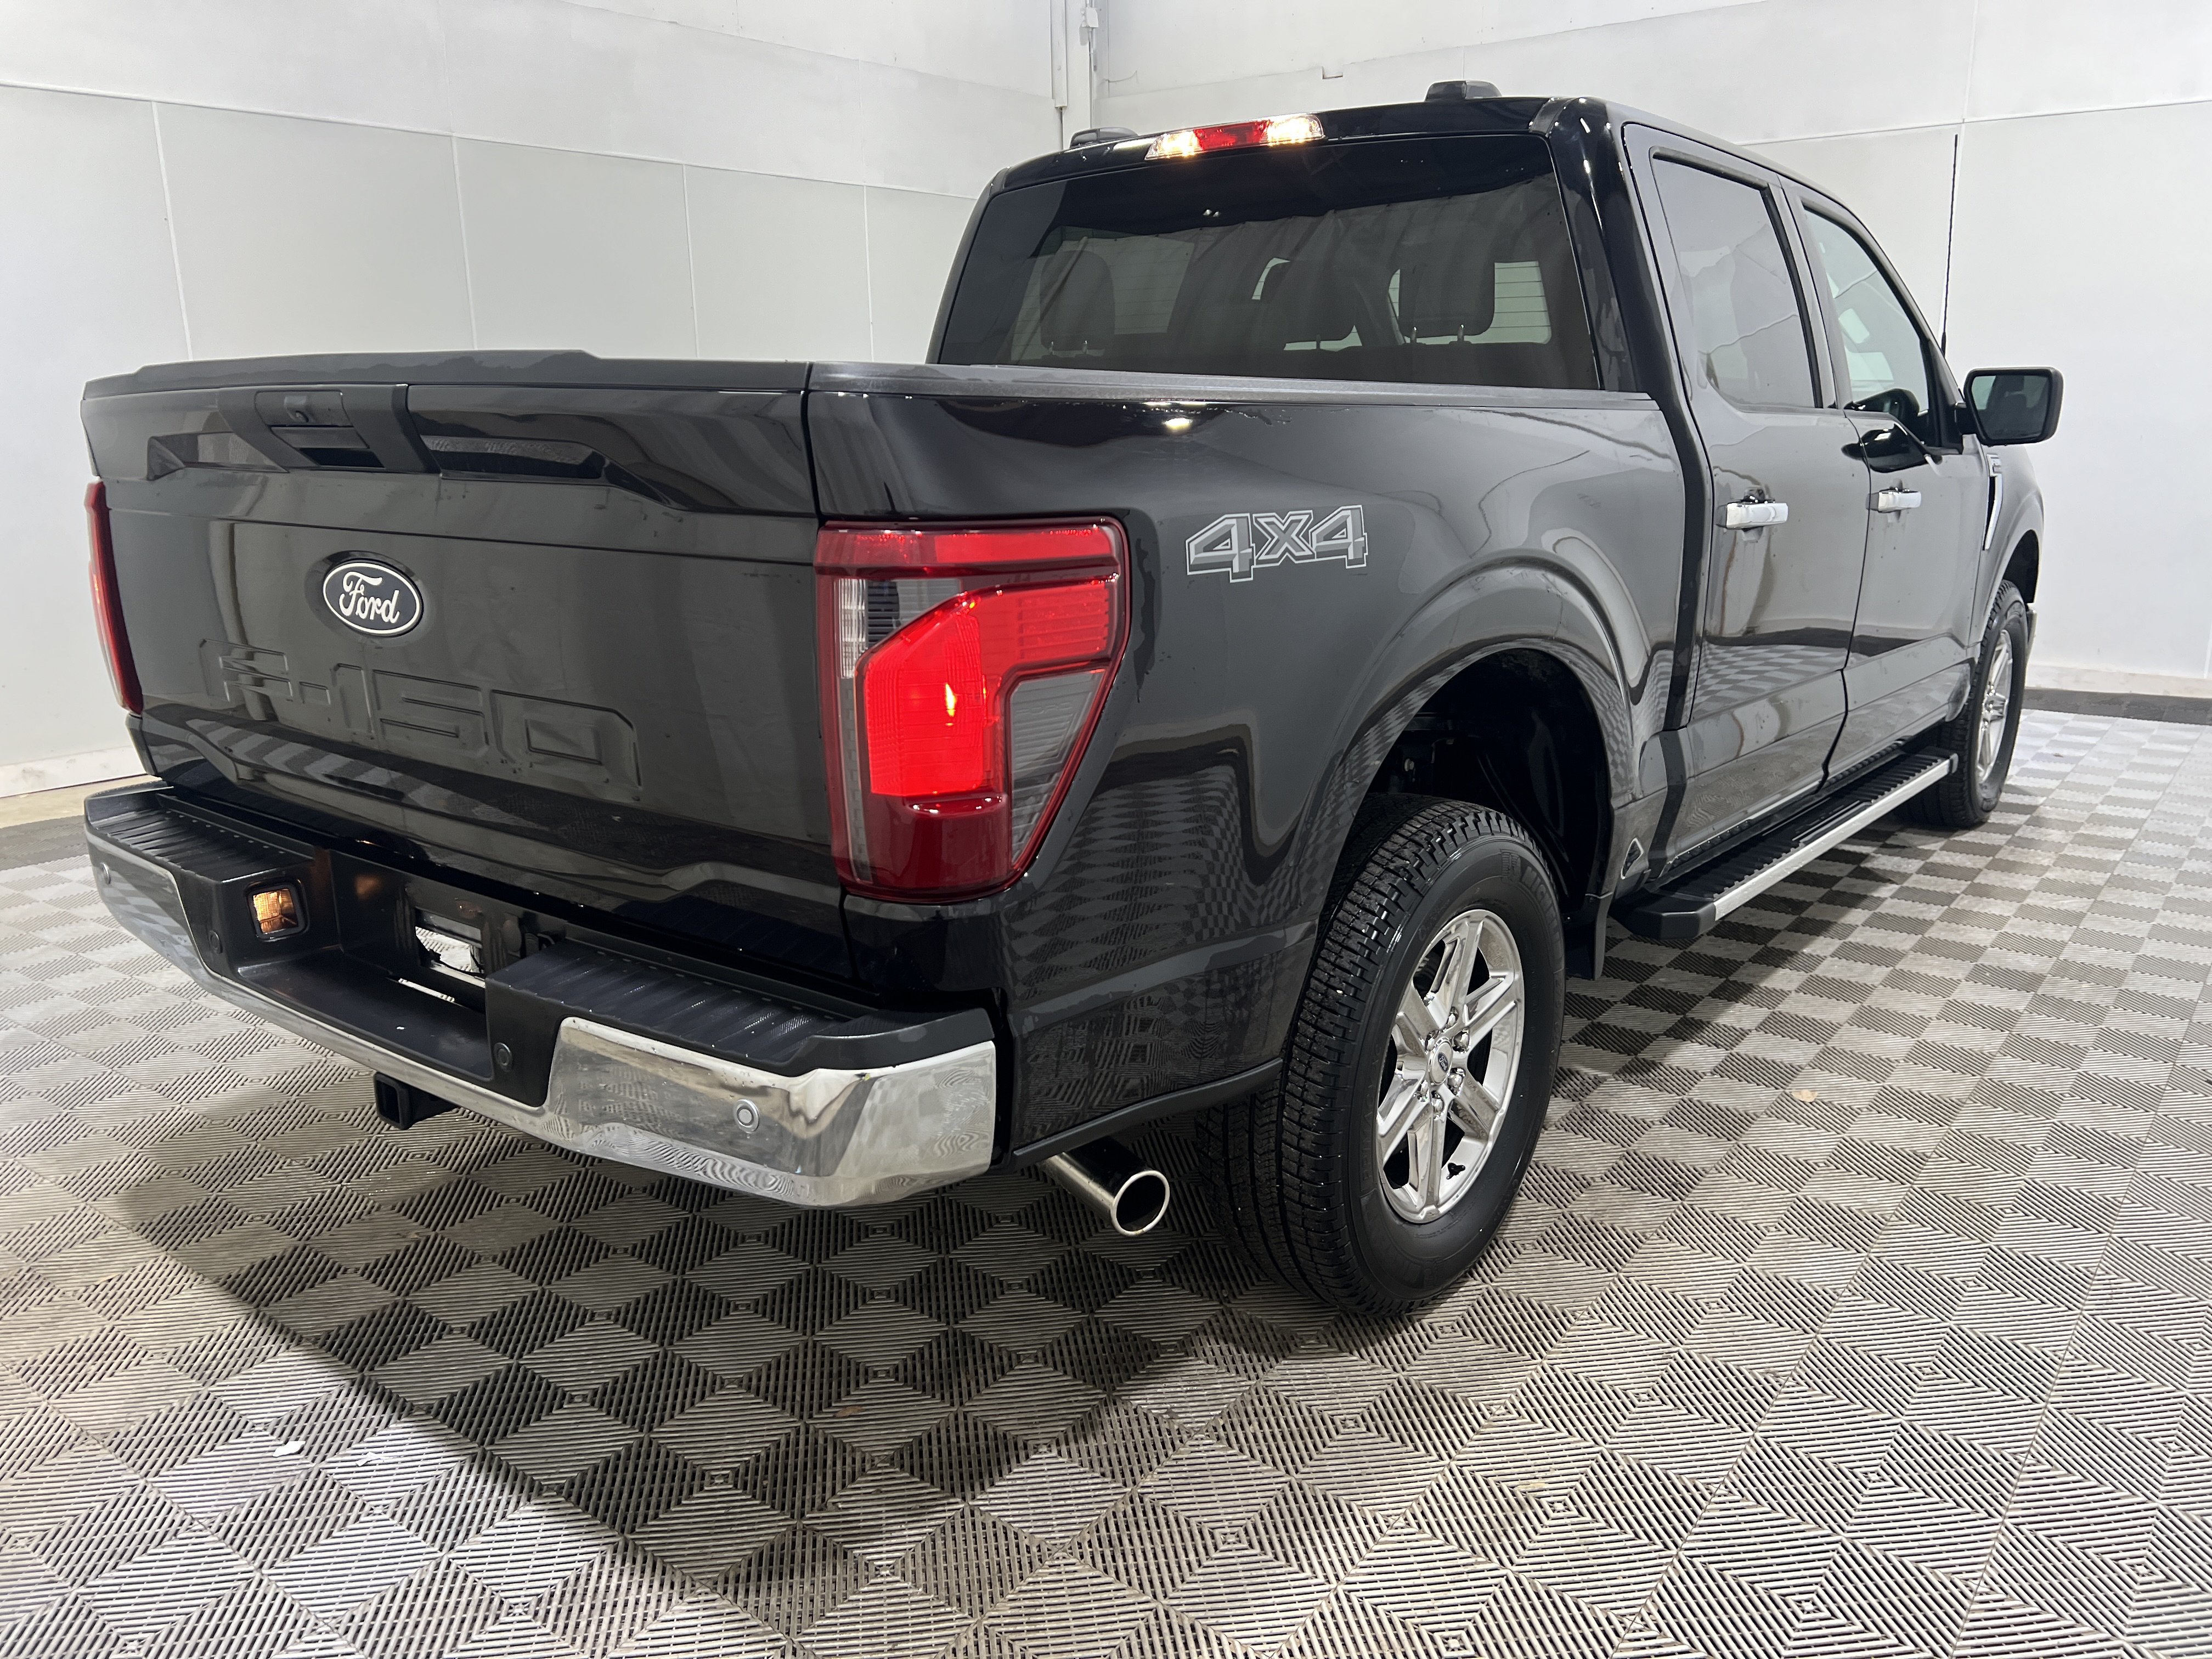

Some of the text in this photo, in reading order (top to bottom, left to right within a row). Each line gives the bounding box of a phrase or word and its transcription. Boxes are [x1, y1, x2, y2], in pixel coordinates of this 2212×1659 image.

[339, 571, 400, 623] Ford
[201, 638, 642, 788] F-150
[1016, 702, 1073, 716] FORD
